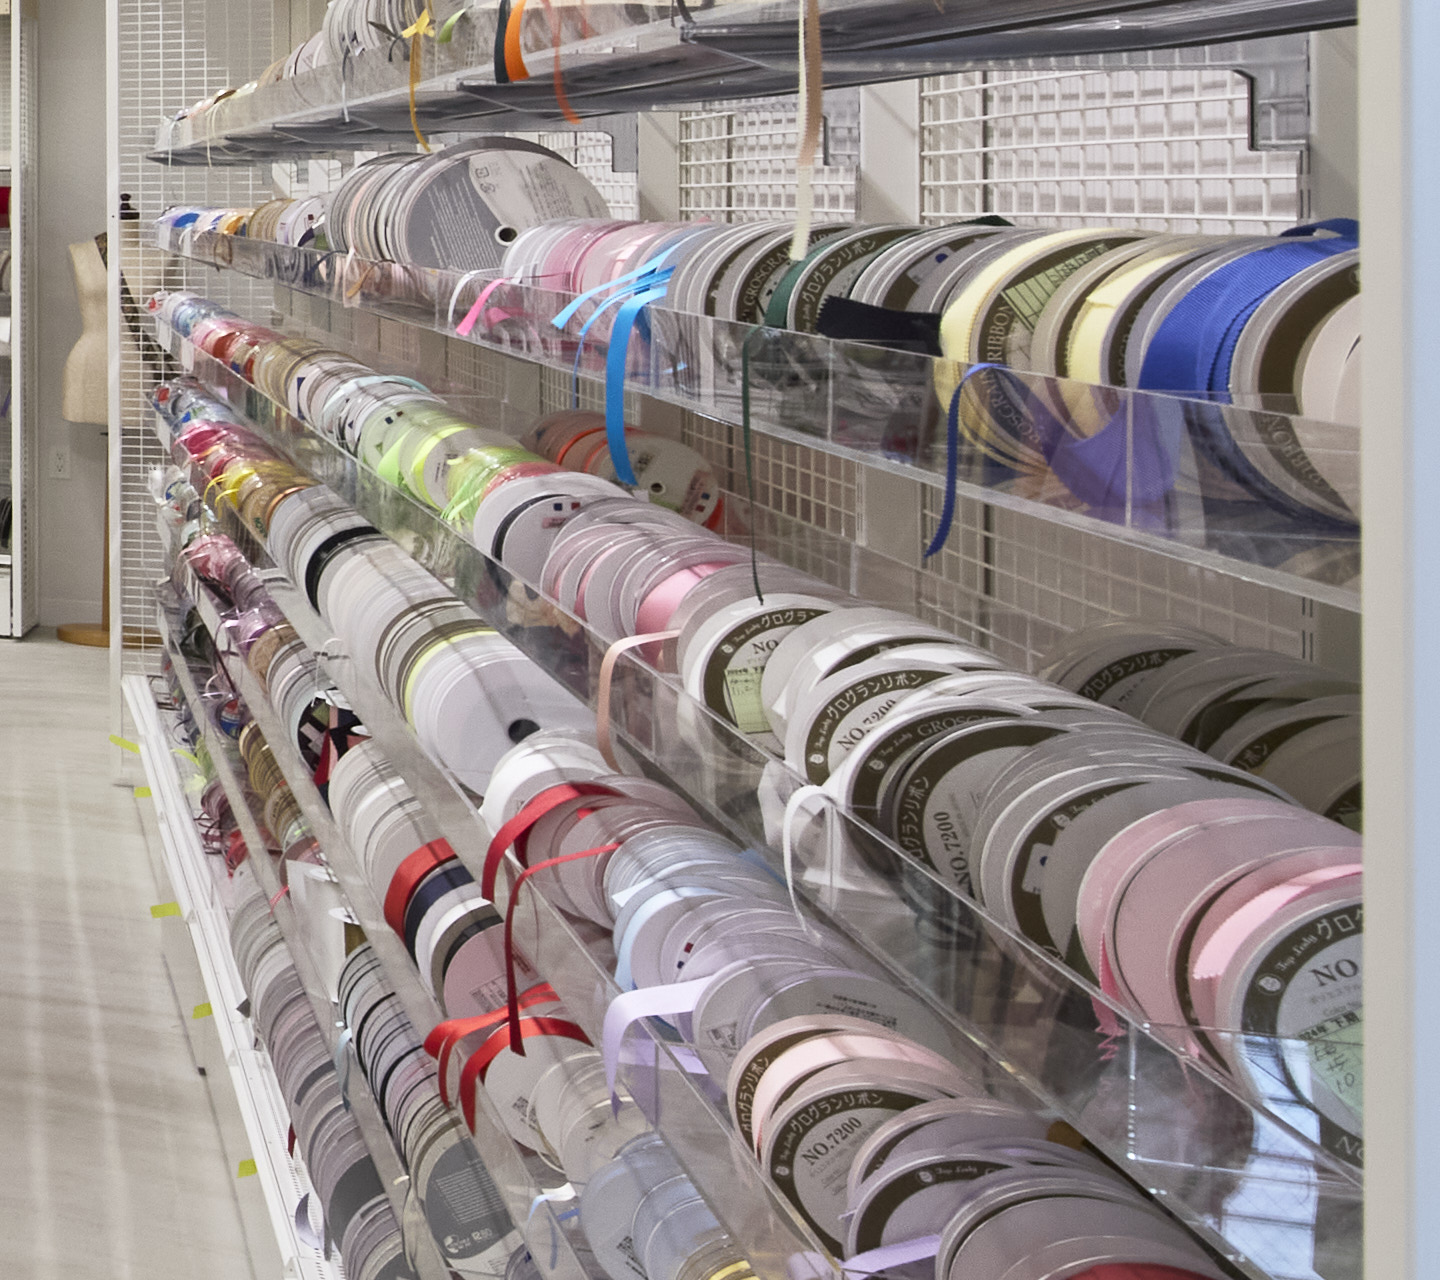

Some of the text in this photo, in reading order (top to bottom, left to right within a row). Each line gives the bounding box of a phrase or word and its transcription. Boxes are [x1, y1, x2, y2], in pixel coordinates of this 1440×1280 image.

[826, 672, 923, 719] グログランリボン
[790, 1092, 885, 1133] グログランリボン
[801, 1116, 863, 1166] NO.7200
